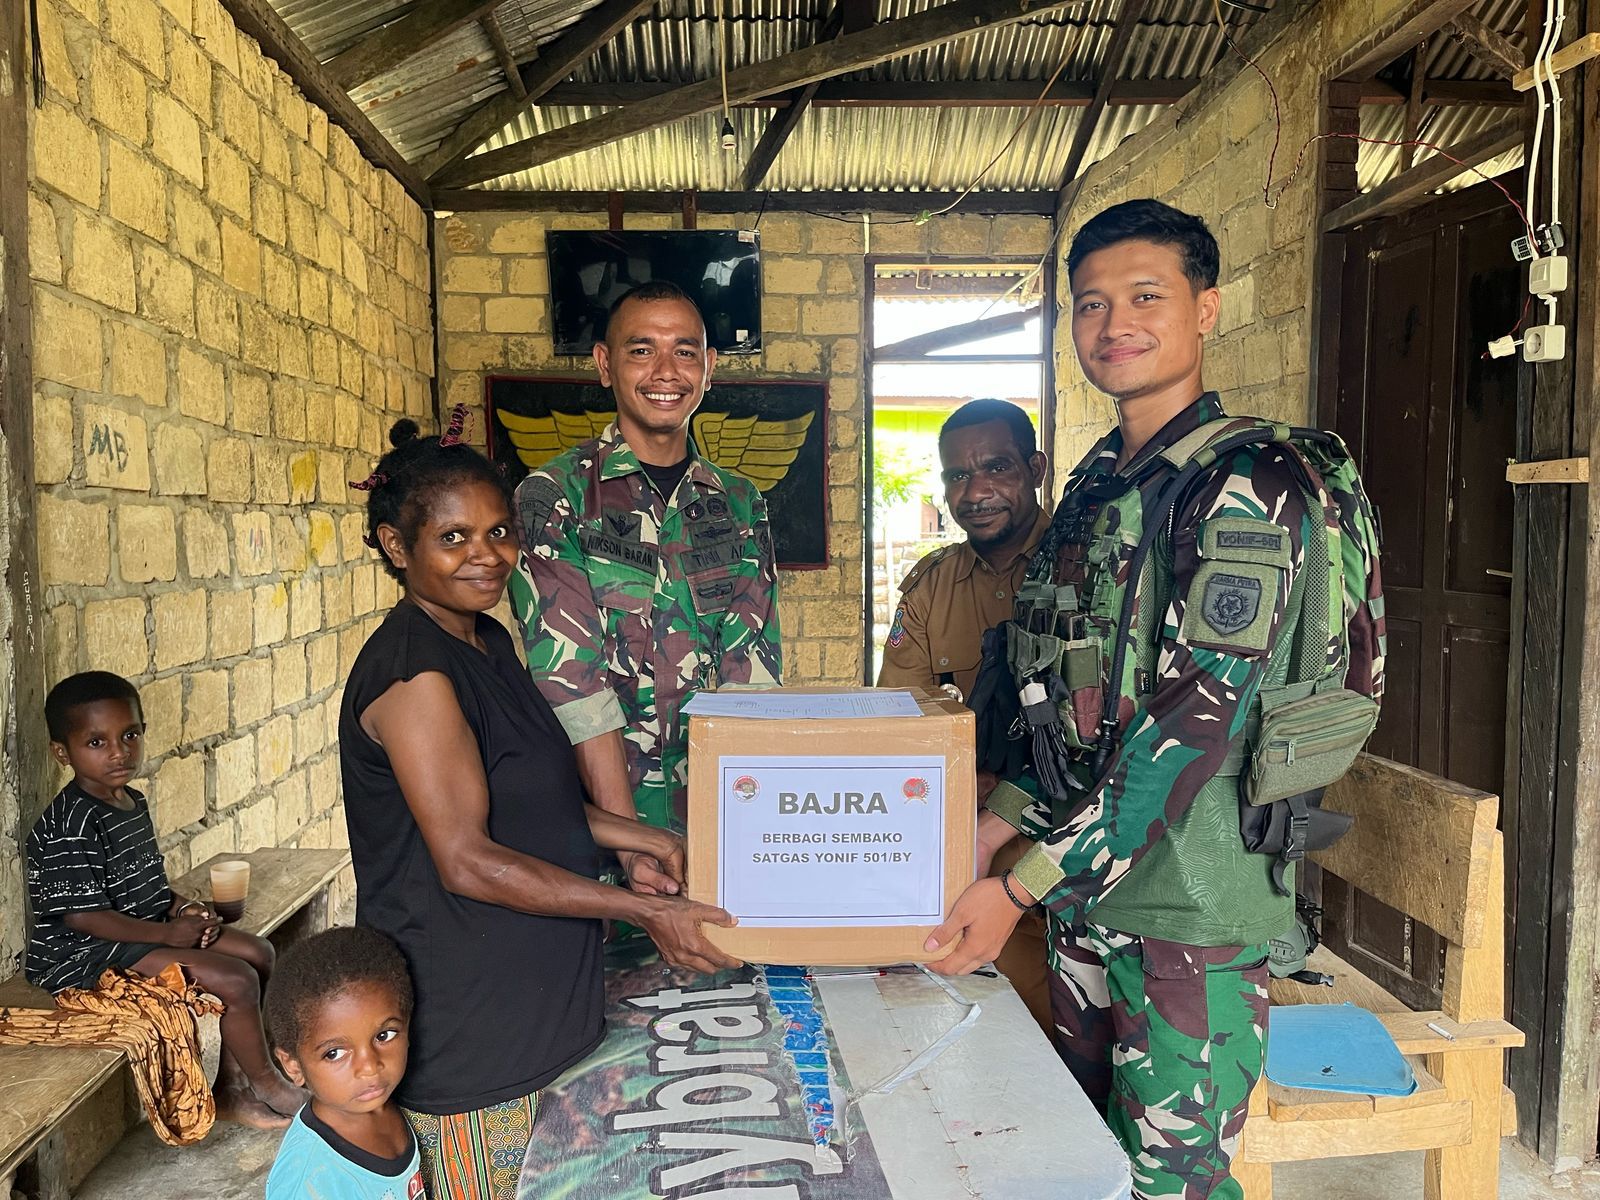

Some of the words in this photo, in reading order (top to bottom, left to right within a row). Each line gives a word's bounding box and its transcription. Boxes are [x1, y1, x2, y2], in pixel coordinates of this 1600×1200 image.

[87, 423, 128, 473] MB
[587, 535, 622, 557] NIKSON
[1221, 534, 1279, 547] YONIF-501
[778, 791, 889, 815] BAJRA
[762, 833, 827, 844] BERBAGI
[831, 832, 903, 843] SEMBAKO
[752, 852, 810, 863] SATGAS
[814, 852, 859, 863] YONIF
[863, 851, 912, 863] 501/BY
